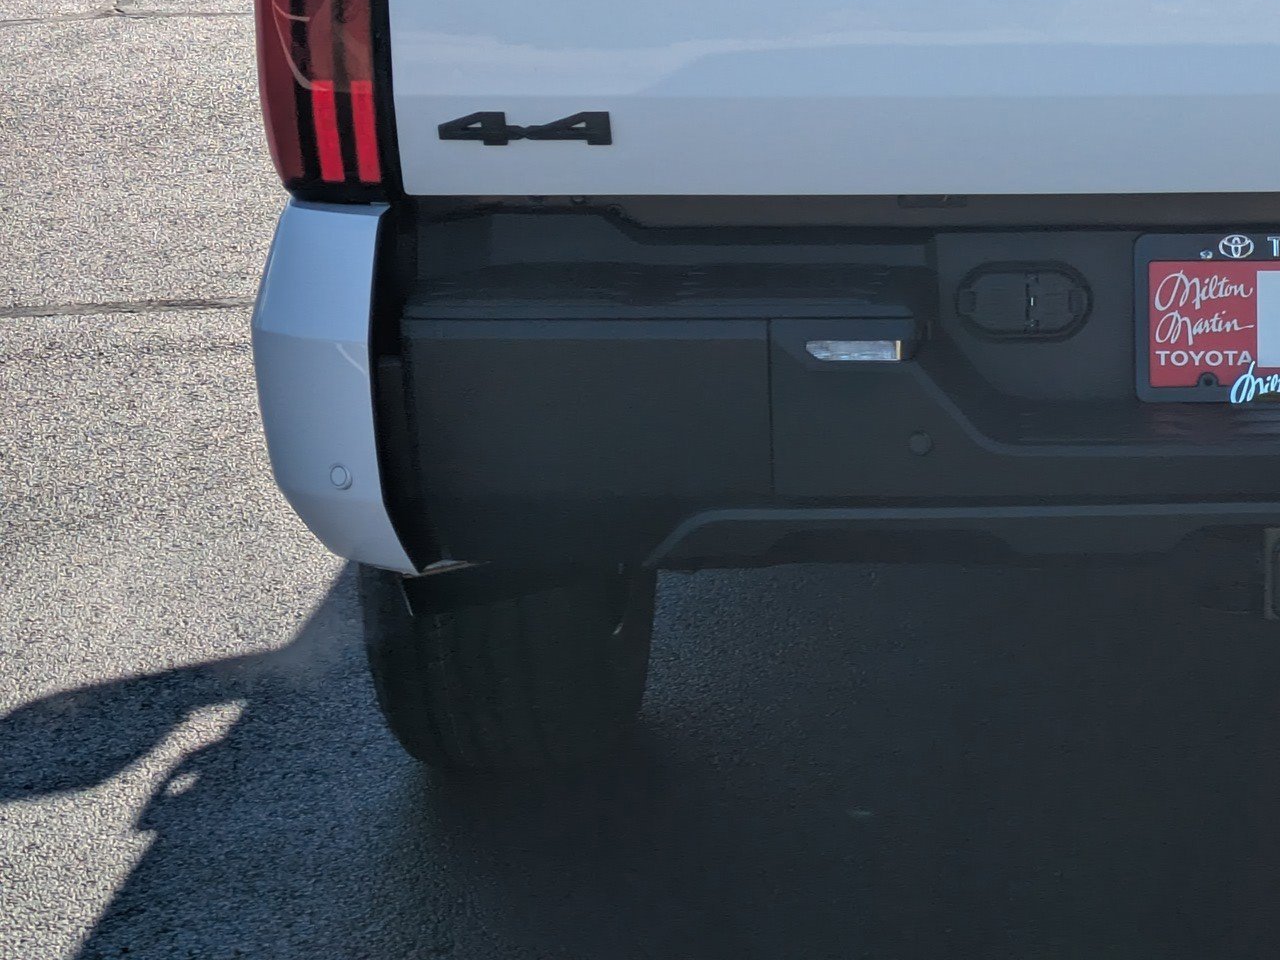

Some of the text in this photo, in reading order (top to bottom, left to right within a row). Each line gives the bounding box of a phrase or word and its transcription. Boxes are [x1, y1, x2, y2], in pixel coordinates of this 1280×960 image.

[1154, 269, 1254, 311] Milton
[1155, 310, 1255, 346] Martin
[1155, 350, 1254, 366] TOYOTA
